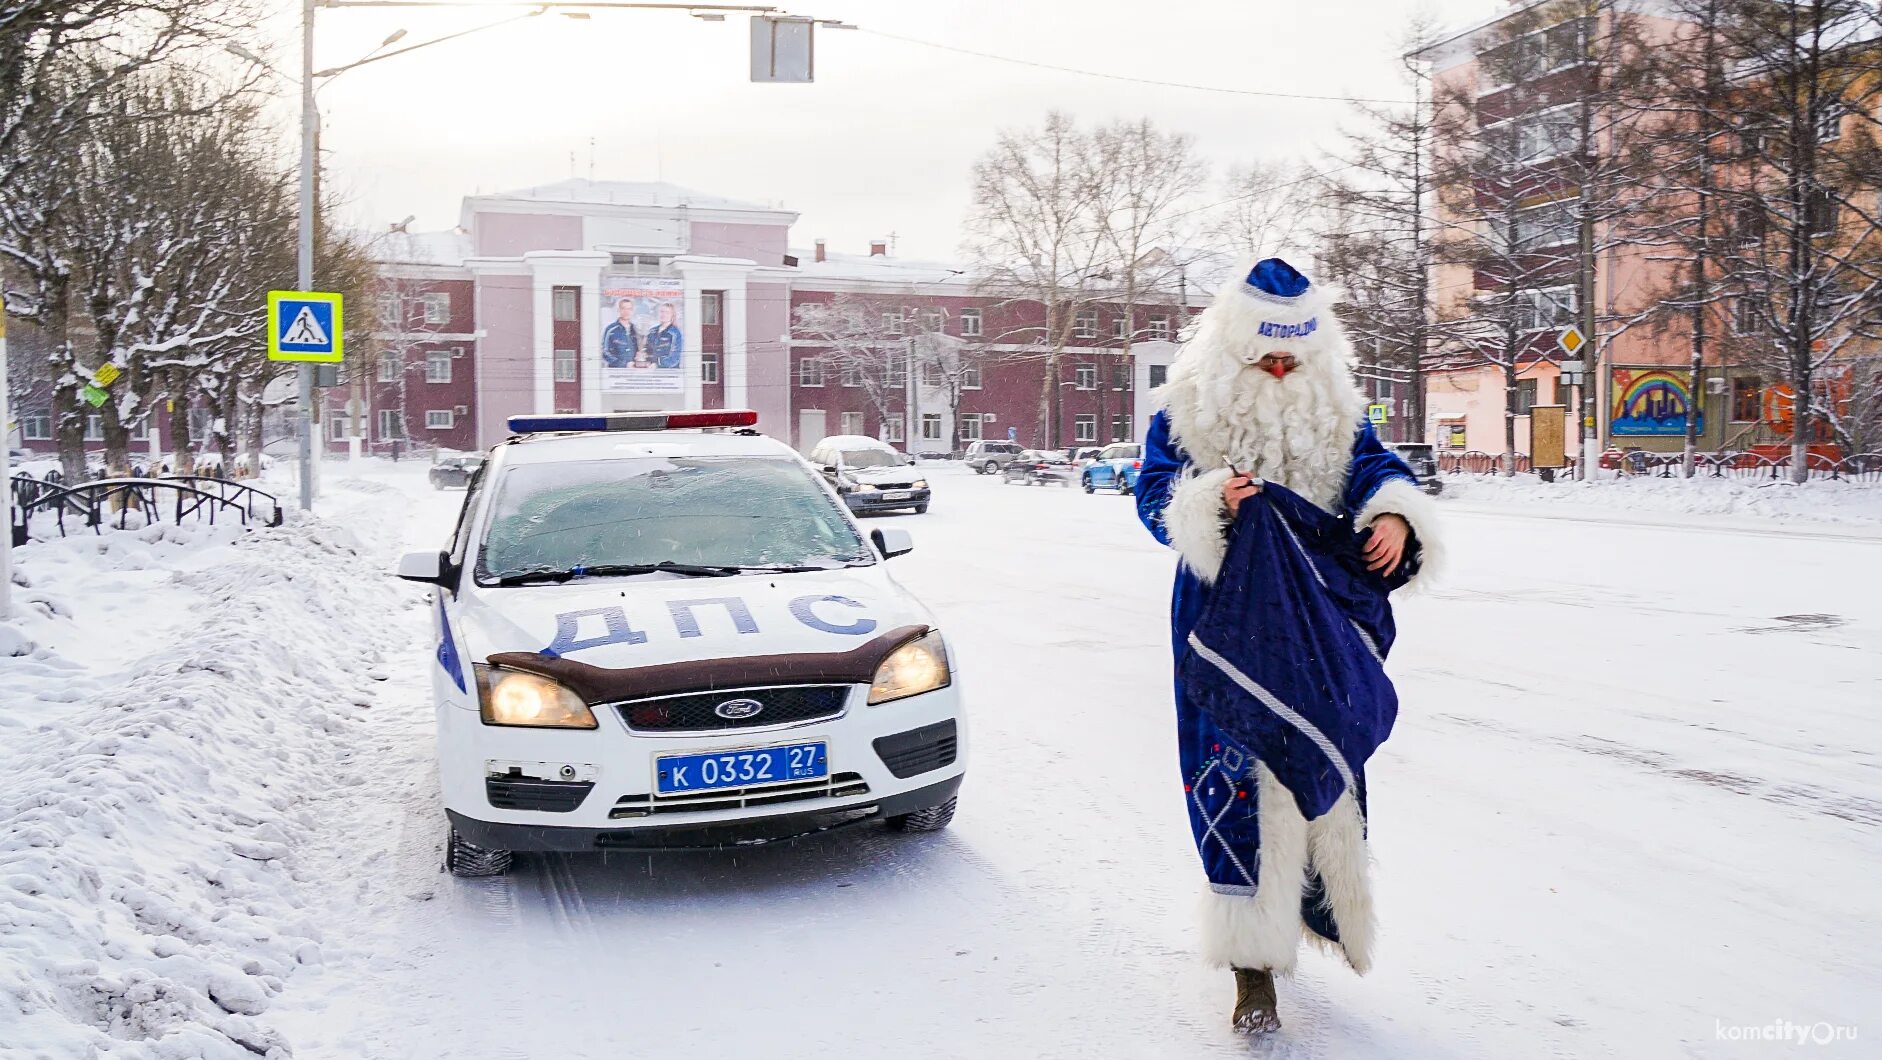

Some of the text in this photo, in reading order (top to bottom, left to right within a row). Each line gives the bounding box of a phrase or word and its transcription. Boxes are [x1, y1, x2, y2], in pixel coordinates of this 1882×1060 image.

[541, 595, 877, 659] ДПС
[701, 754, 773, 785] 0332
[789, 746, 817, 768] 27
[793, 768, 814, 776] RUS
